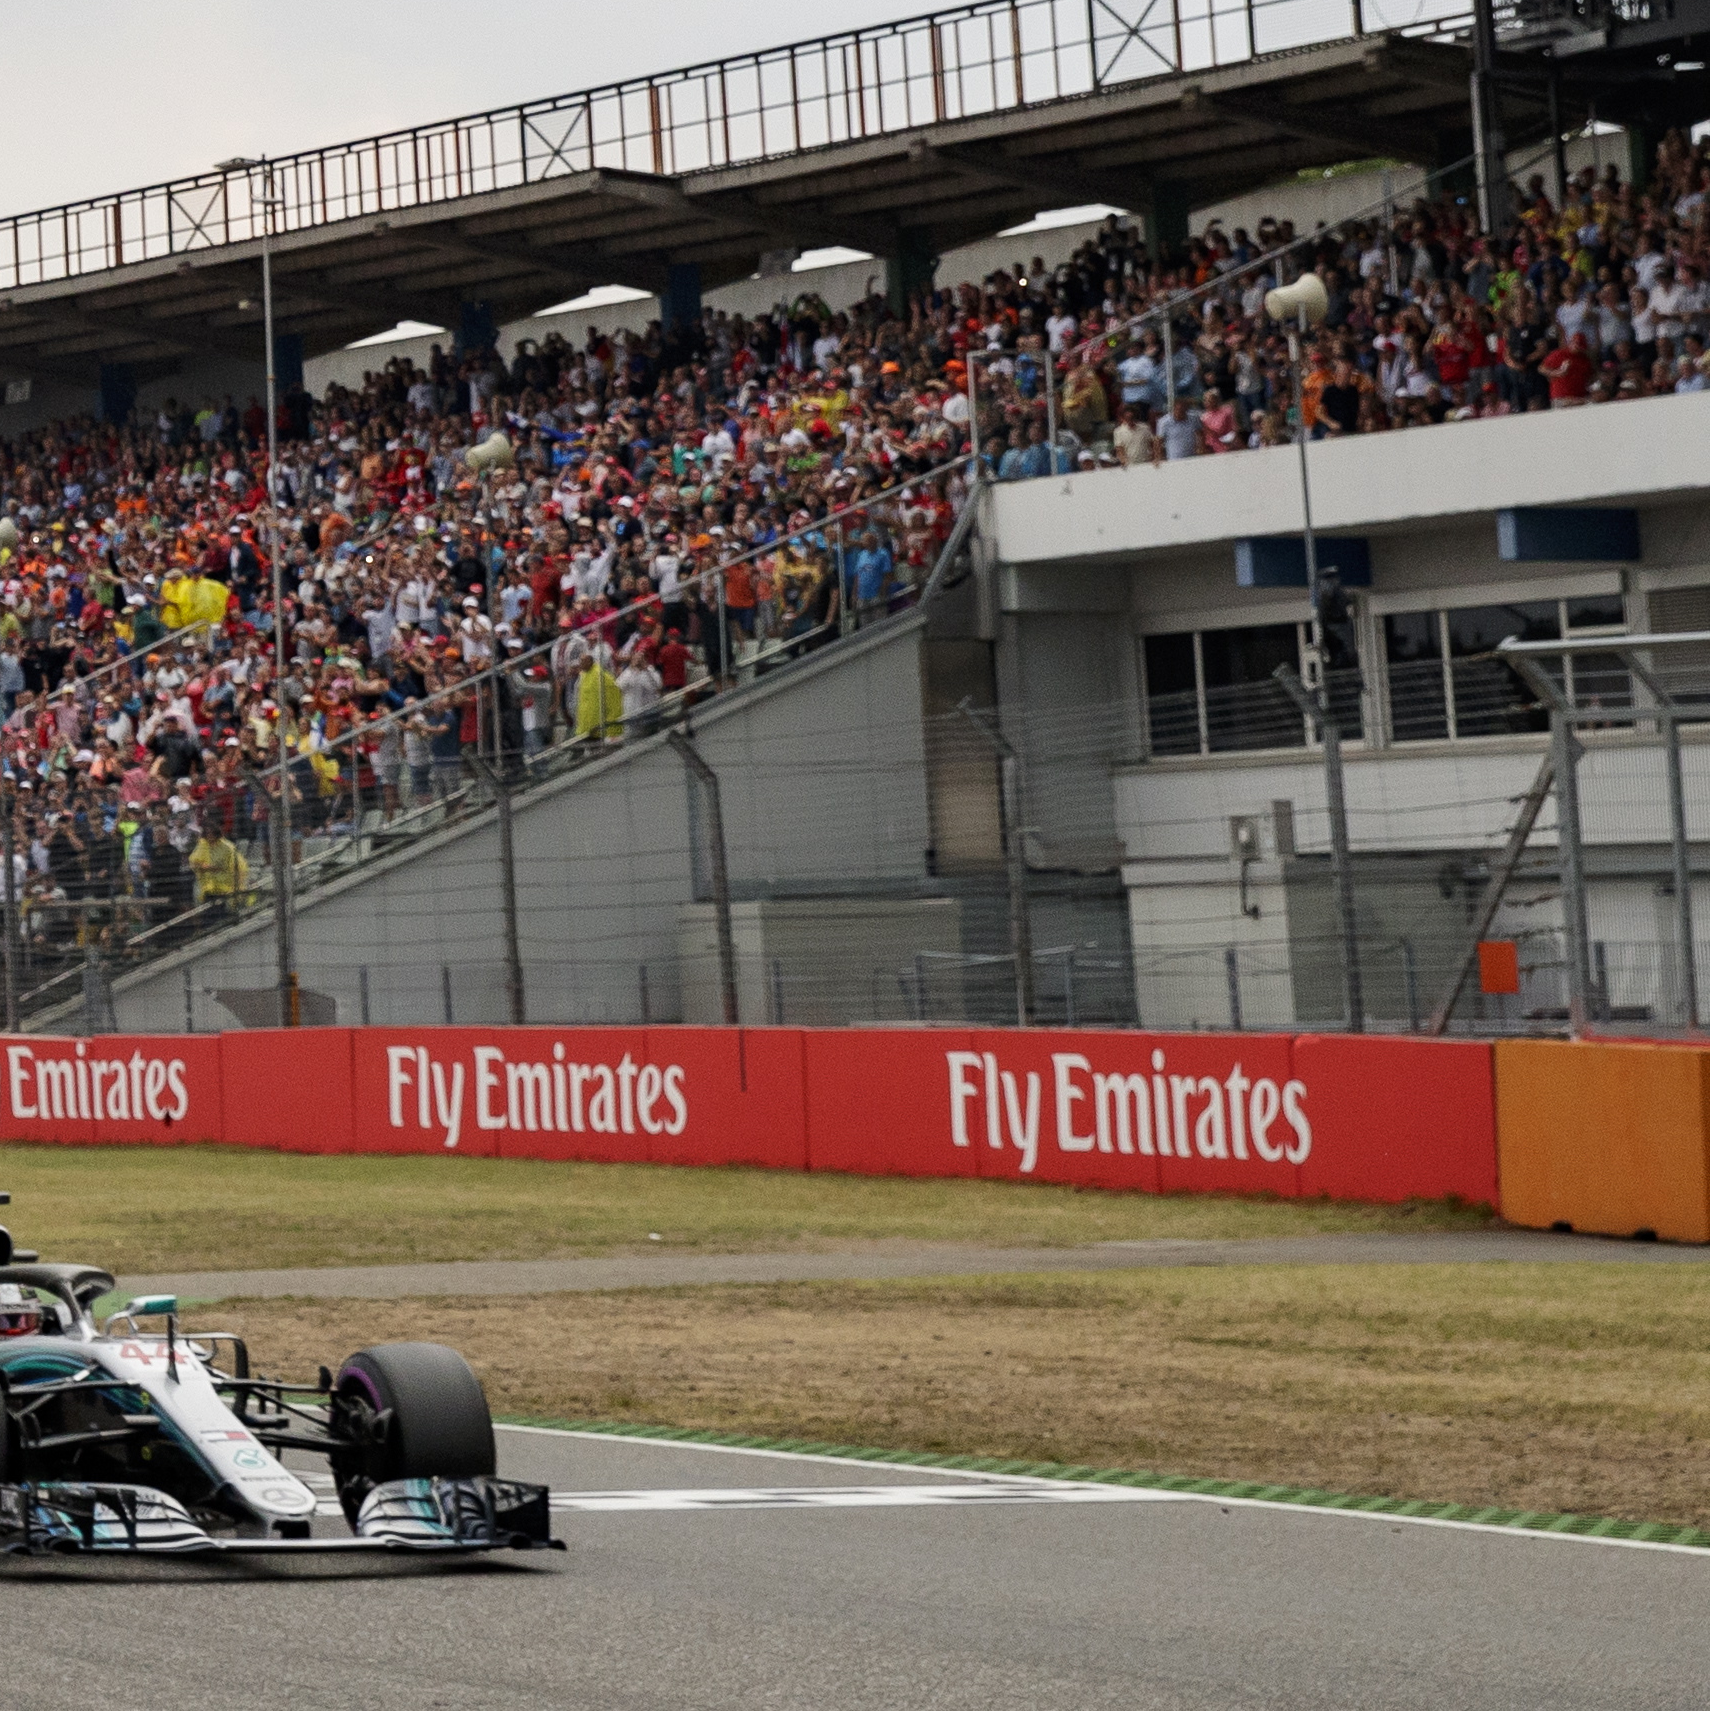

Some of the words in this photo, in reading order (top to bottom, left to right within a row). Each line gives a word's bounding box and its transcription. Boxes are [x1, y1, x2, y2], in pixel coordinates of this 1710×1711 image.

[6, 1039, 188, 1121] Emirates
[386, 1045, 465, 1148] Fly
[473, 1041, 688, 1136] Emirates
[946, 1051, 1041, 1173] Fly
[1051, 1048, 1312, 1165] Emirates
[120, 1343, 188, 1365] 44
